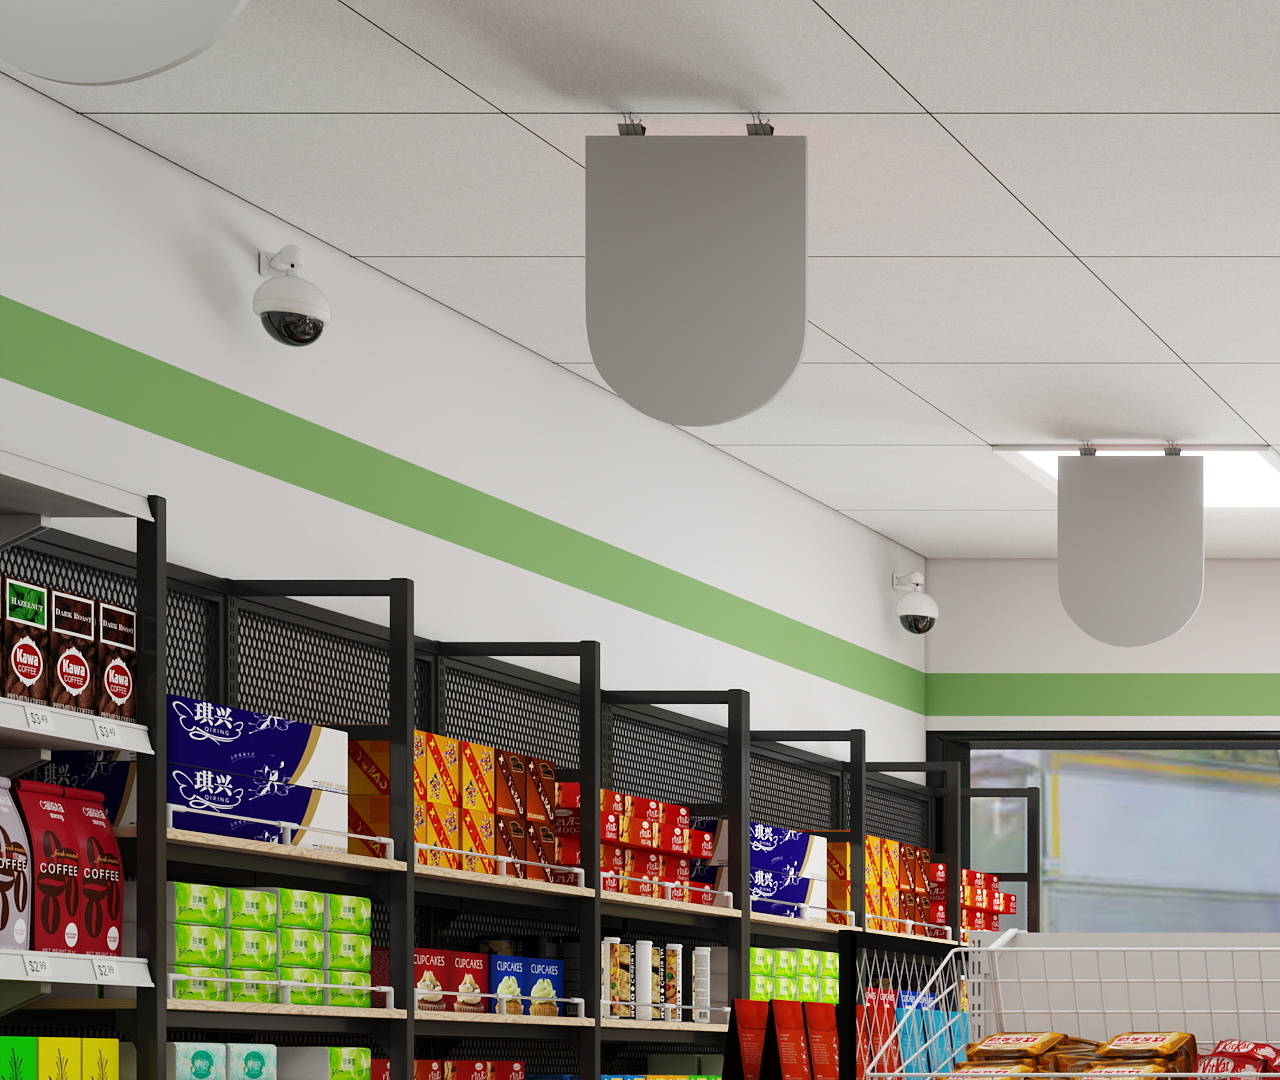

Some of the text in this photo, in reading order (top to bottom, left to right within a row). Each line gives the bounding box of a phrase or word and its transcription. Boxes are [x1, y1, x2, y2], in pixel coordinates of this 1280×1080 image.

[11, 596, 43, 612] HAZELNUT
[55, 607, 92, 624] DARK ROAST
[102, 619, 134, 635] DARK ROAST
[16, 648, 39, 666] Kawa
[18, 664, 38, 676] COFFEE
[62, 659, 86, 676] Kawa
[64, 674, 84, 686] COFFEE
[109, 669, 129, 686] Kawa
[110, 684, 127, 695] COFFEE
[7, 692, 30, 702] PREMIUM
[53, 702, 75, 712] PREMIUM
[194, 701, 233, 729] 琪兴
[204, 726, 230, 737] QIXING
[194, 769, 233, 797] 琪兴
[204, 793, 230, 804] QIXING
[0, 858, 27, 872] OFFEE
[39, 862, 78, 877] COFFEE
[83, 867, 119, 882] COFFEE
[414, 953, 445, 967] CUPCAKES
[454, 957, 483, 970] CUPCAKES
[496, 960, 523, 973] CUPCAKES
[530, 963, 558, 975] CUPCAKES
[1218, 1040, 1251, 1052] KitKat
[1201, 1056, 1232, 1074] KitKat
